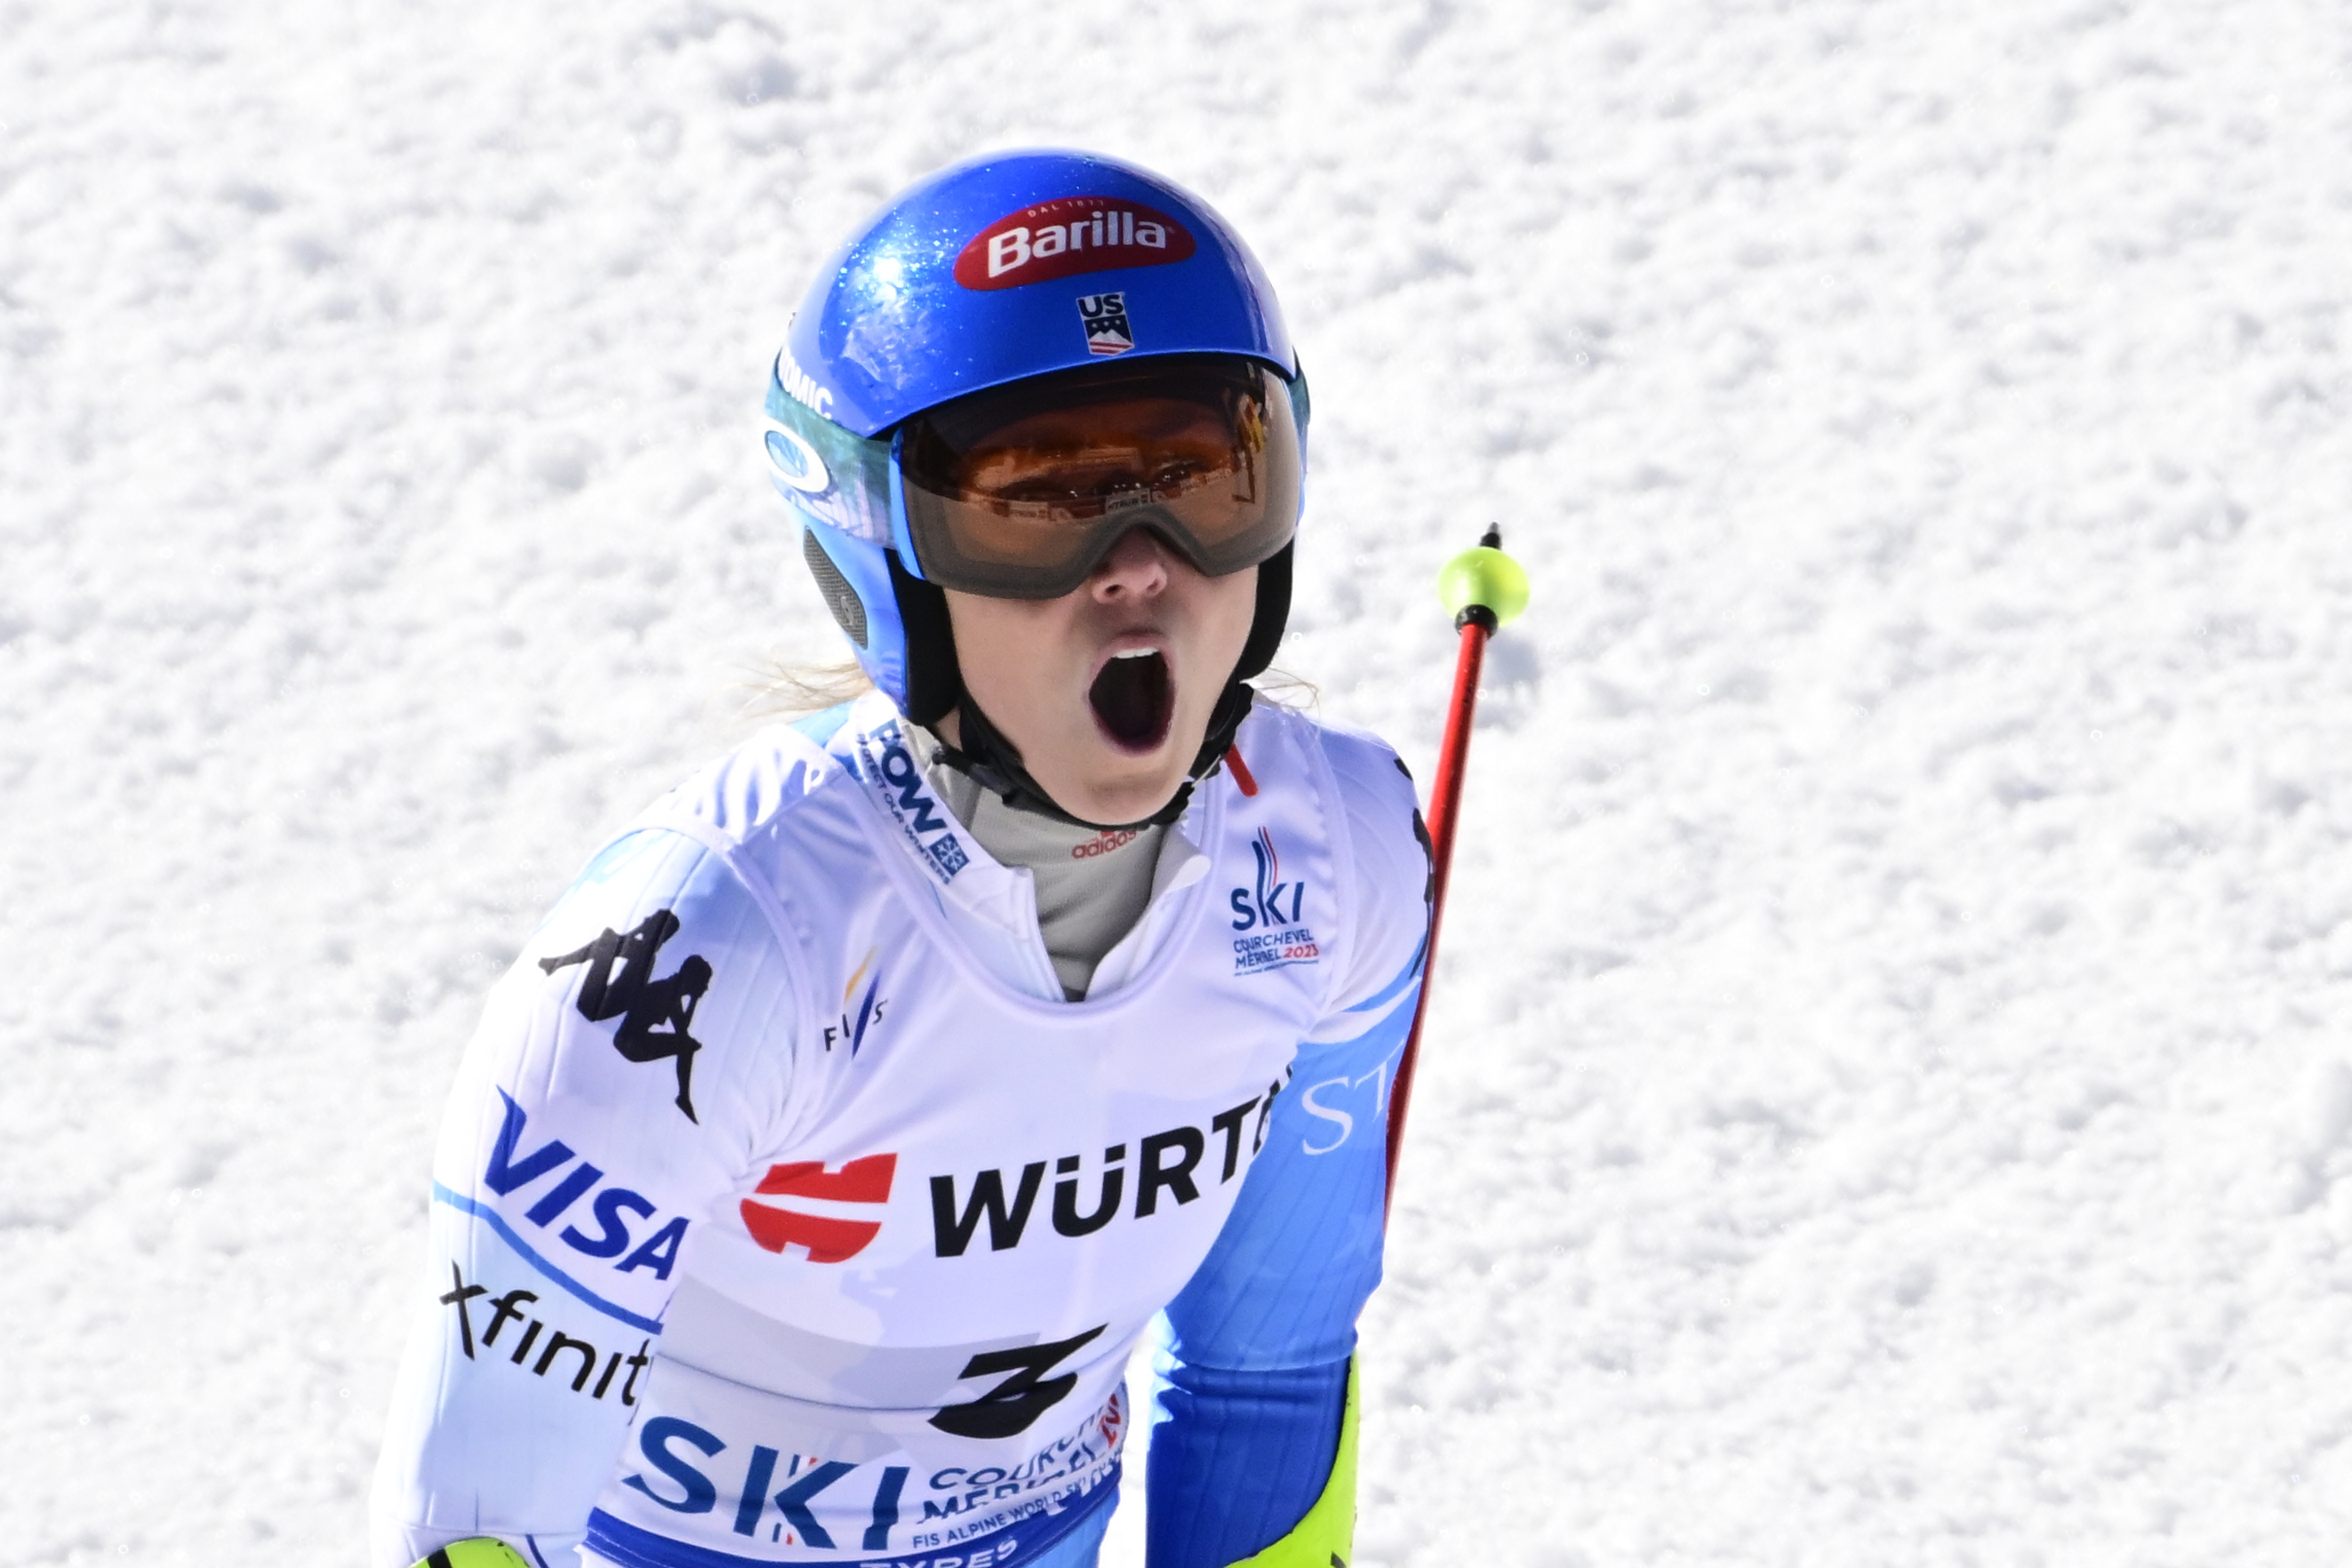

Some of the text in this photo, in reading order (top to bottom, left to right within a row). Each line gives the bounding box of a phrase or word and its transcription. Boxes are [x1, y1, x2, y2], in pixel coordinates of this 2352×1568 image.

[988, 211, 1167, 278] Barilla
[1028, 204, 1060, 218] DAL
[1077, 293, 1124, 317] US
[1071, 828, 1137, 860] adidas
[1230, 840, 1305, 932] SKI
[1233, 928, 1315, 954] COURCHEVEL
[484, 1084, 692, 1281] VISA
[438, 1259, 652, 1407] xfinit
[927, 1322, 1109, 1440] 3
[621, 1415, 910, 1551] SKI
[913, 1532, 940, 1548] FIS
[947, 1514, 1008, 1544] ALPINE
